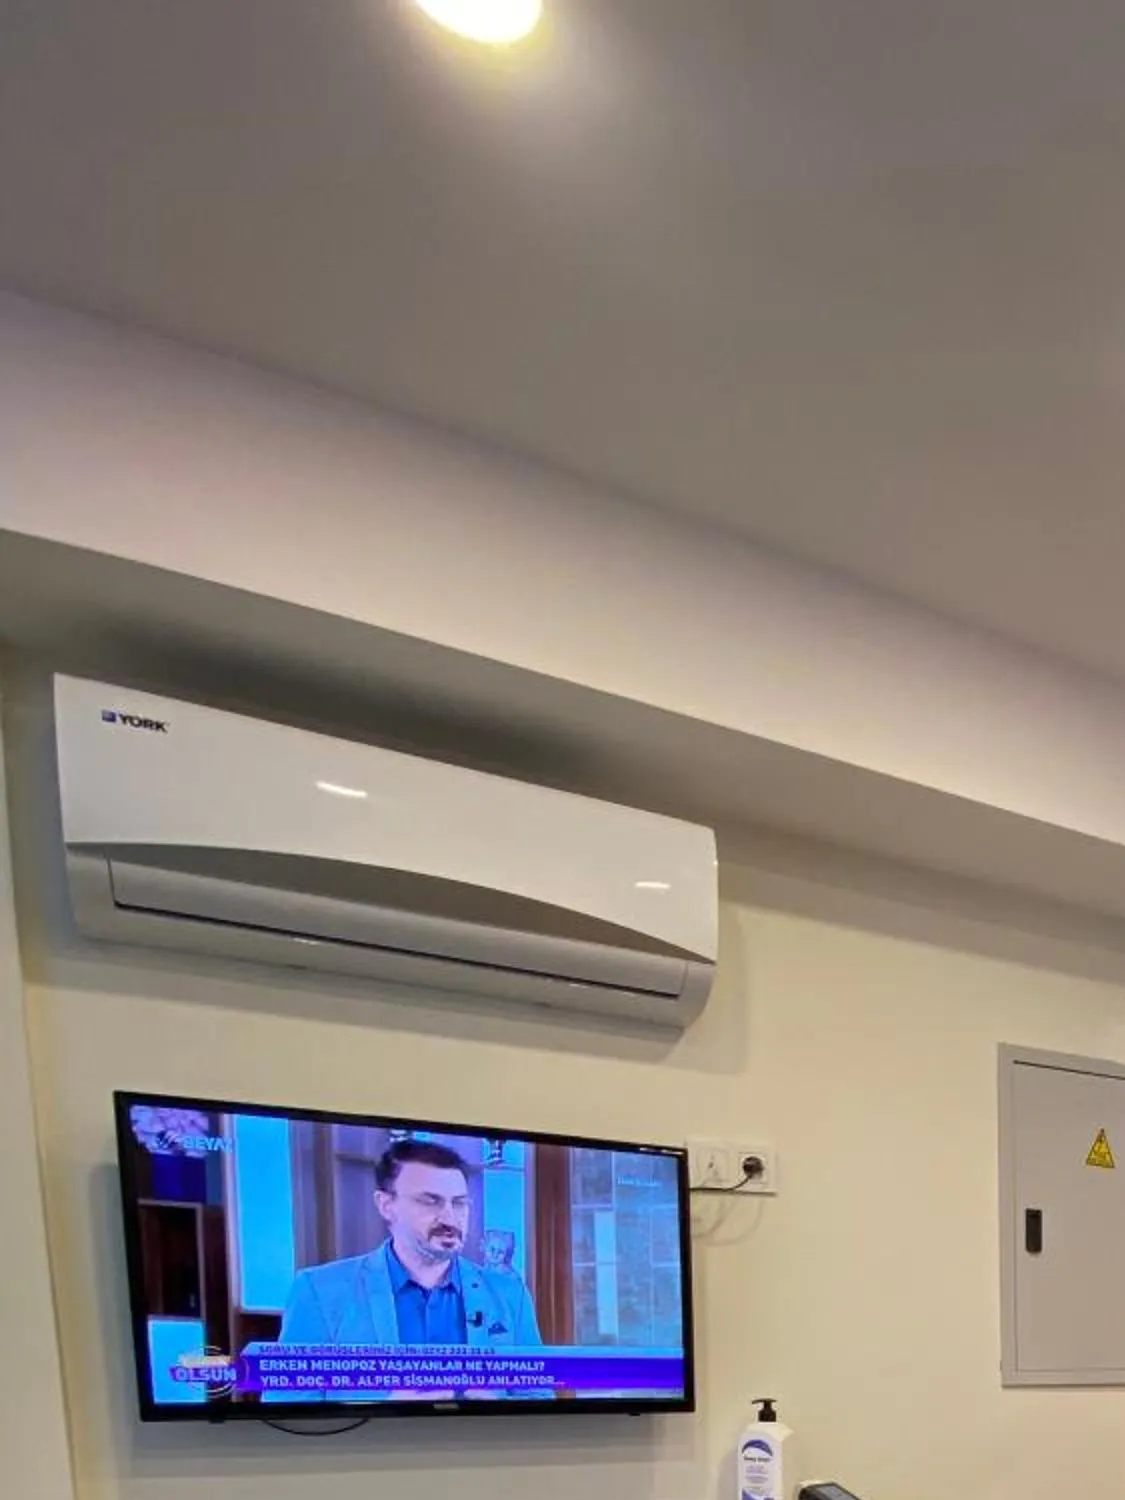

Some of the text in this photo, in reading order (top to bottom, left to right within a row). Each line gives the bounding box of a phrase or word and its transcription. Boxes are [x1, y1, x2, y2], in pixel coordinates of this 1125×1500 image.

[119, 713, 169, 733] YORK
[259, 1359, 308, 1371] ERKEN
[311, 1359, 376, 1371] MENOPOZ
[465, 1360, 483, 1371] NE
[175, 1367, 237, 1380] OLSUN
[357, 1375, 401, 1387] ALPER
